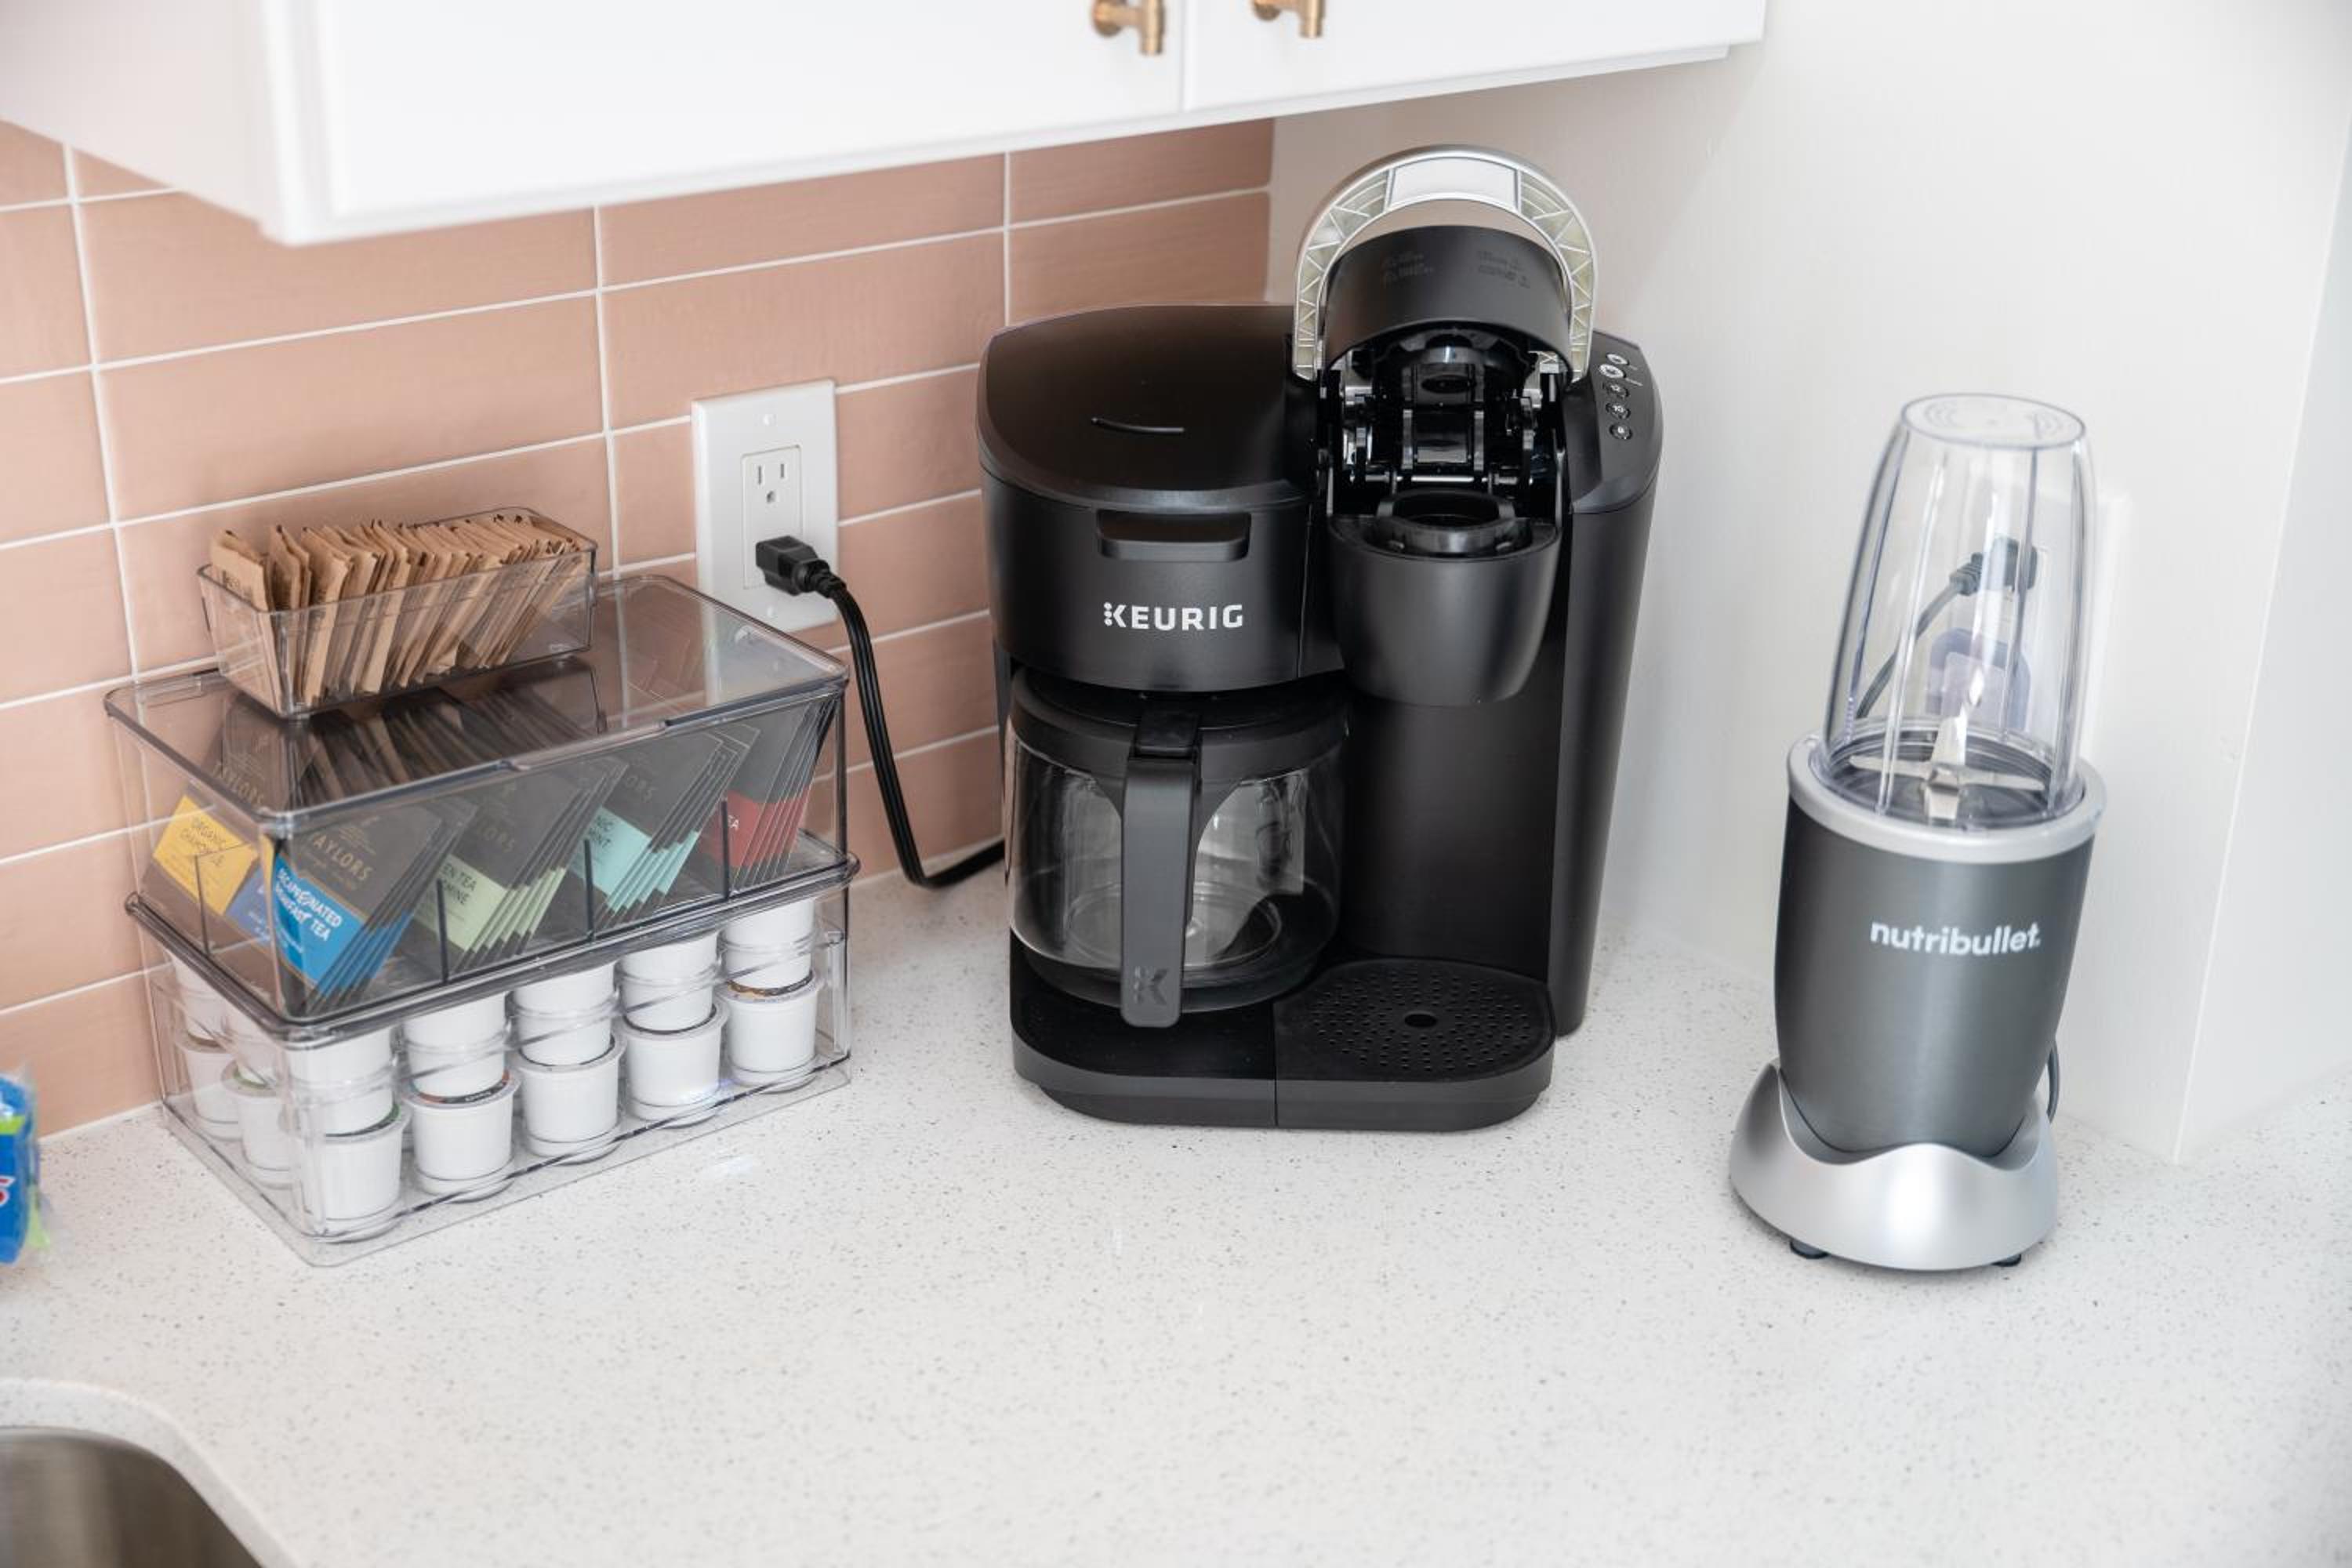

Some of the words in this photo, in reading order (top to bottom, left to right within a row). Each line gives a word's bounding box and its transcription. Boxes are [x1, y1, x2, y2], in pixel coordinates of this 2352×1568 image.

[1104, 602, 1243, 631] KEURIG
[460, 871, 477, 891] TEA
[310, 918, 332, 942] TEA
